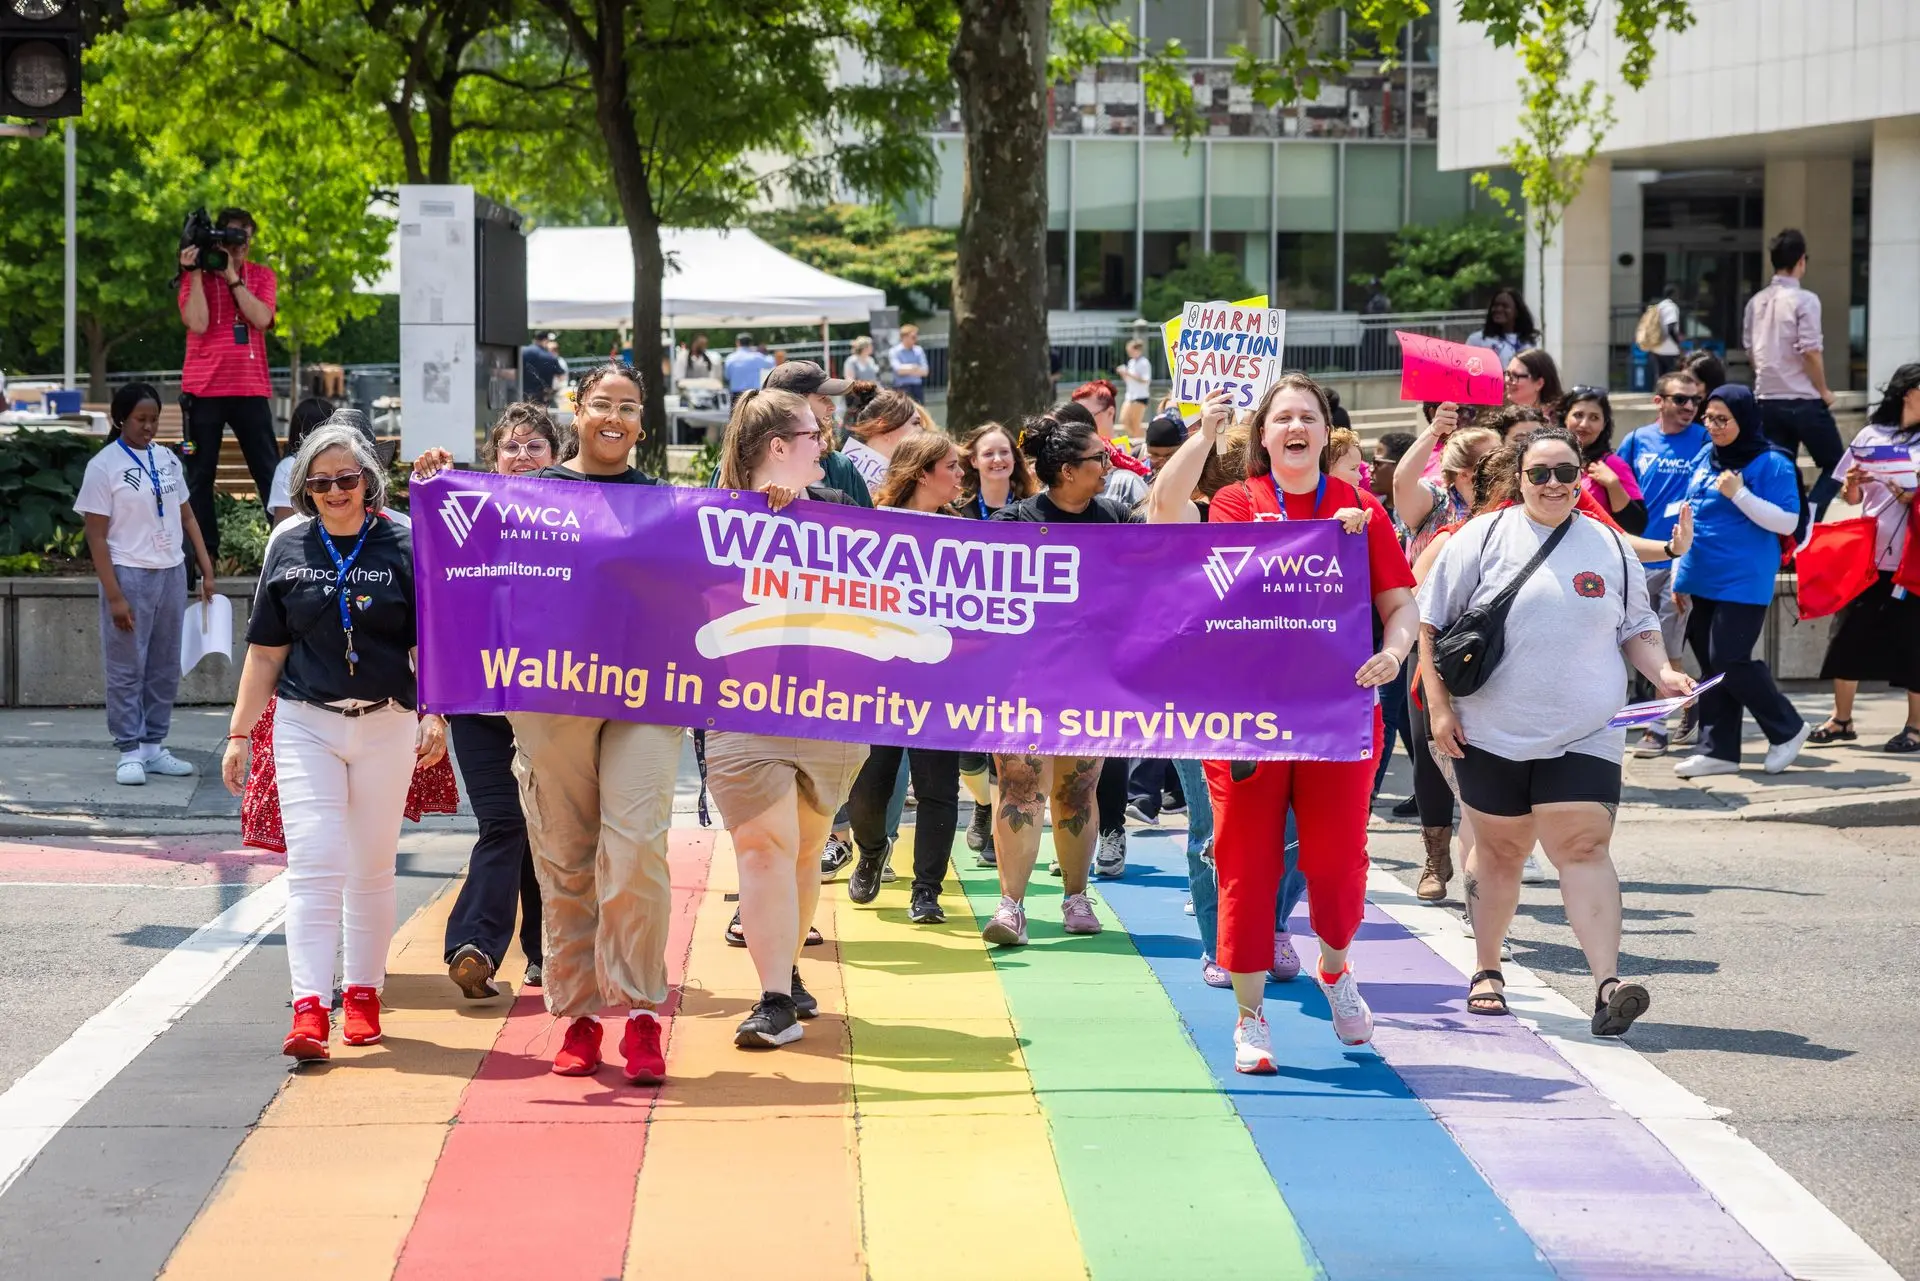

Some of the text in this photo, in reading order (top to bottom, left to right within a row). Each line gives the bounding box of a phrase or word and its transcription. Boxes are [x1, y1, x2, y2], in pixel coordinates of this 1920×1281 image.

[1200, 308, 1261, 334] HARM
[1180, 329, 1278, 357] REDUCTION
[1182, 351, 1263, 379] SAVES
[495, 502, 580, 529] YWCA
[500, 530, 581, 542] HAMILTON
[707, 513, 1073, 594] WALK A MILE
[1258, 555, 1343, 577] YWCA
[446, 562, 572, 581] ywcahamilton.org
[751, 567, 1027, 626] IN THEIR SHOES
[1263, 583, 1343, 593] HAMILTON
[1205, 616, 1337, 632] ywcahamilton.org
[480, 648, 1292, 741] Walking in solidarity with survivors.
